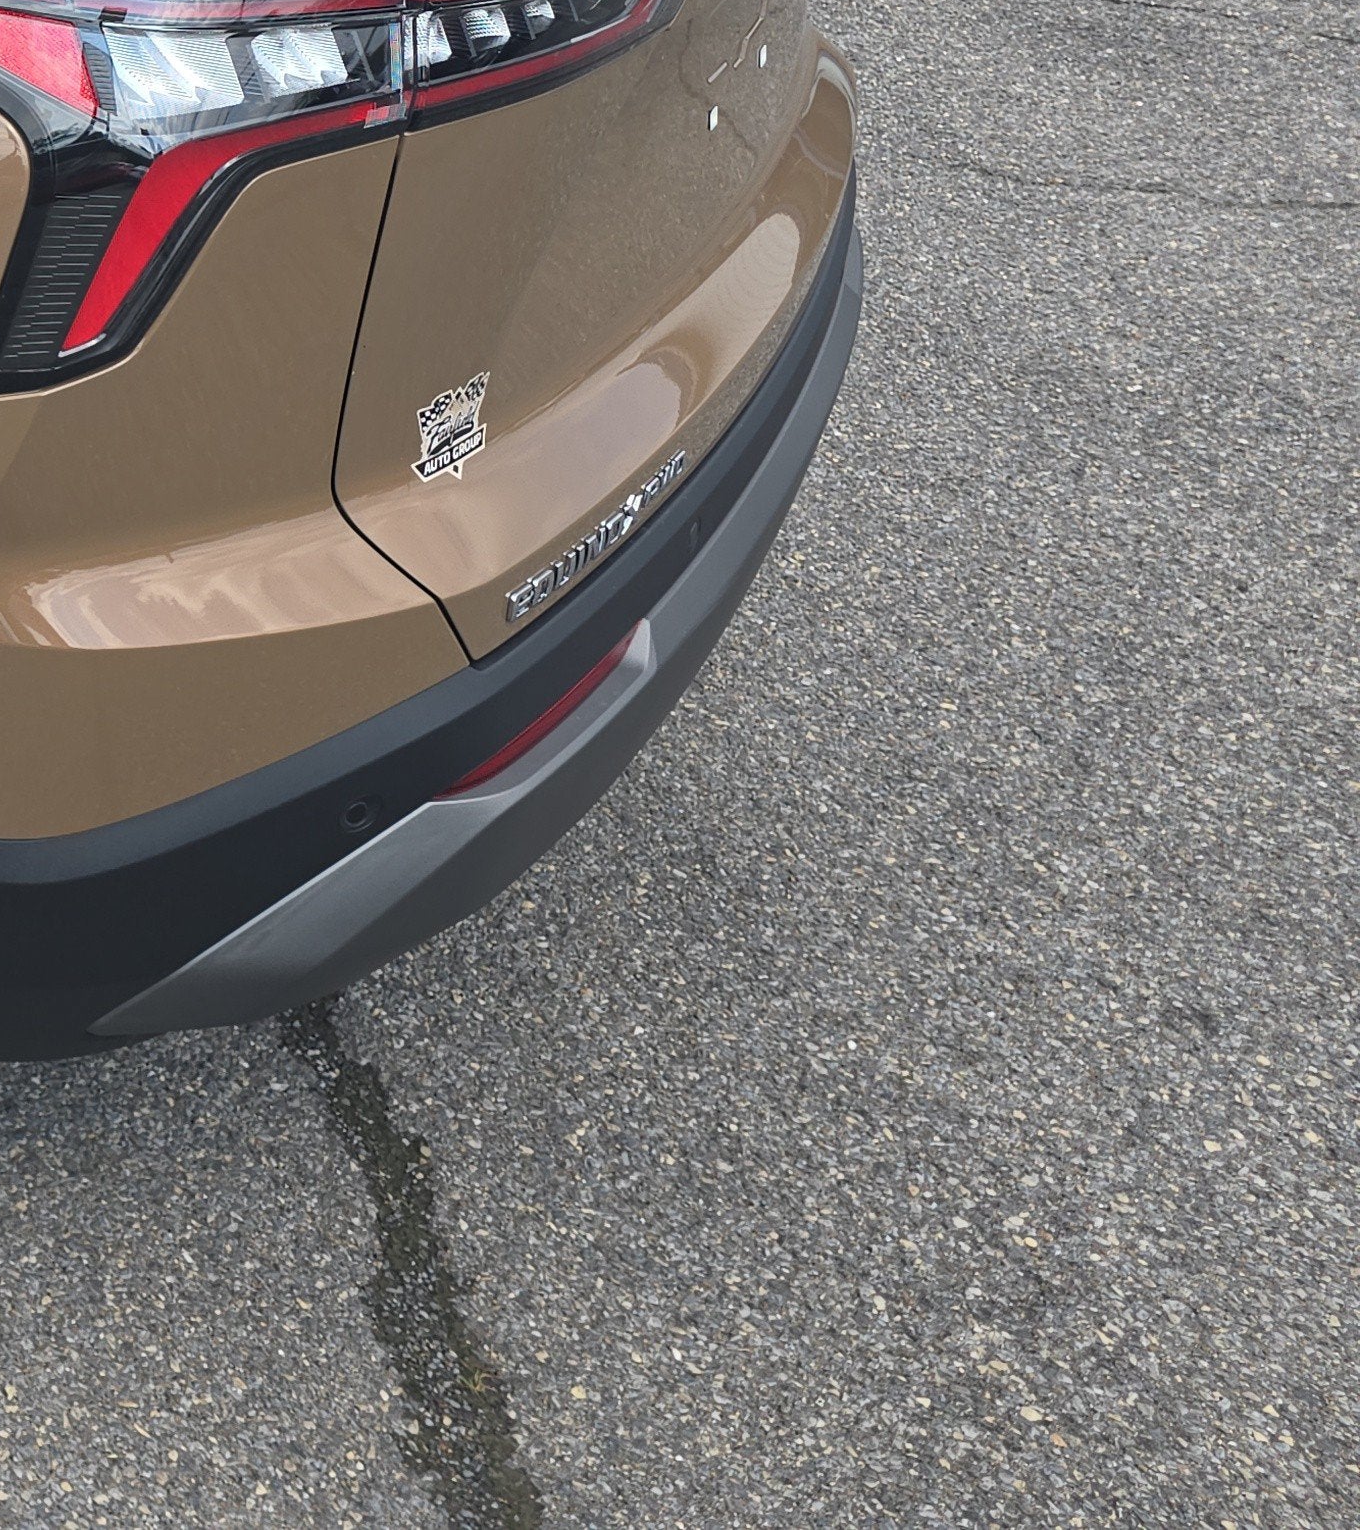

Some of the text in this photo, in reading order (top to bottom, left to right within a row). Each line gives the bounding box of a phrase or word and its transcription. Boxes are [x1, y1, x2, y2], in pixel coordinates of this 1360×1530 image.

[423, 431, 483, 477] AUTO GROUP
[505, 494, 643, 623] EQUINOX
